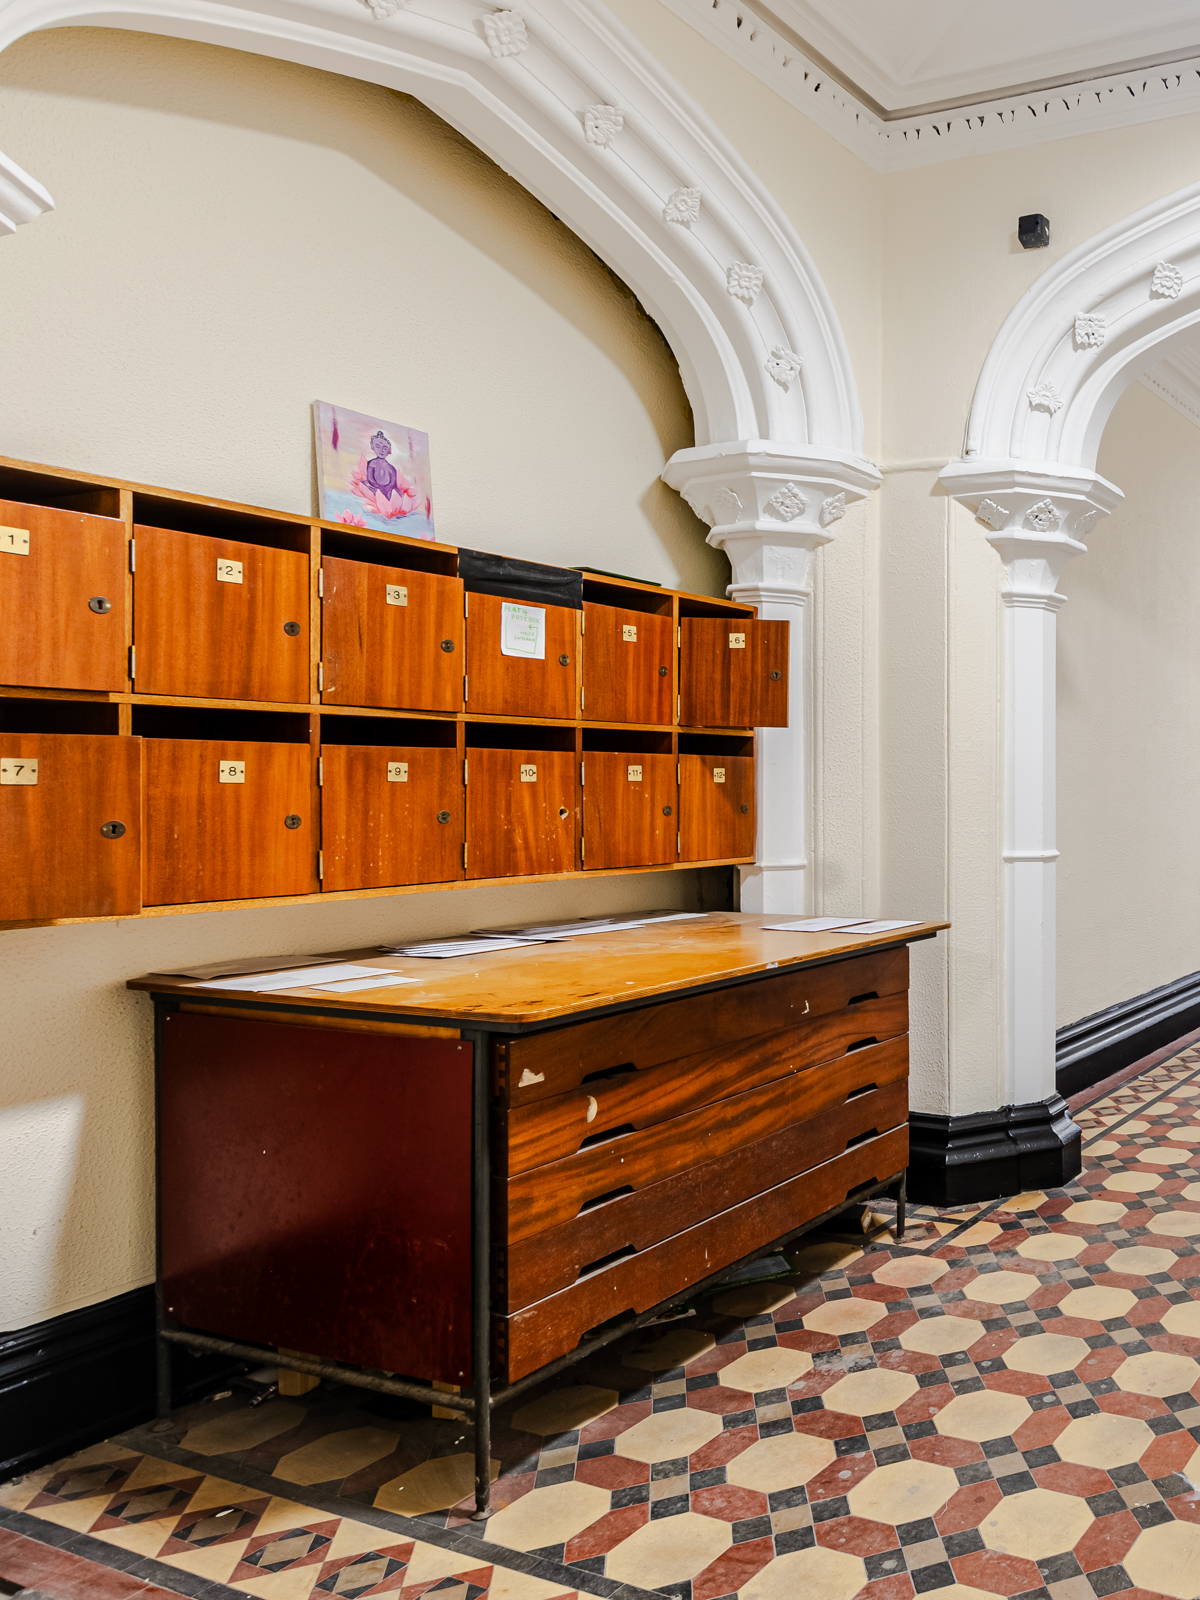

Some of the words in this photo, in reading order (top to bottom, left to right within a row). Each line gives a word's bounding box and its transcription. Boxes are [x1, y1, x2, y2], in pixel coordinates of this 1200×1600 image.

[7, 534, 14, 545] 1
[225, 566, 233, 575] 2
[393, 590, 402, 599] 3
[504, 604, 521, 613] FLAT
[511, 613, 528, 622] POST
[627, 629, 633, 637] 5
[734, 636, 741, 645] 6
[12, 765, 24, 776] 7
[228, 766, 236, 776] 8
[394, 767, 401, 776] 9
[523, 768, 533, 777] 10
[632, 769, 638, 777] 11
[716, 771, 723, 779] 12
